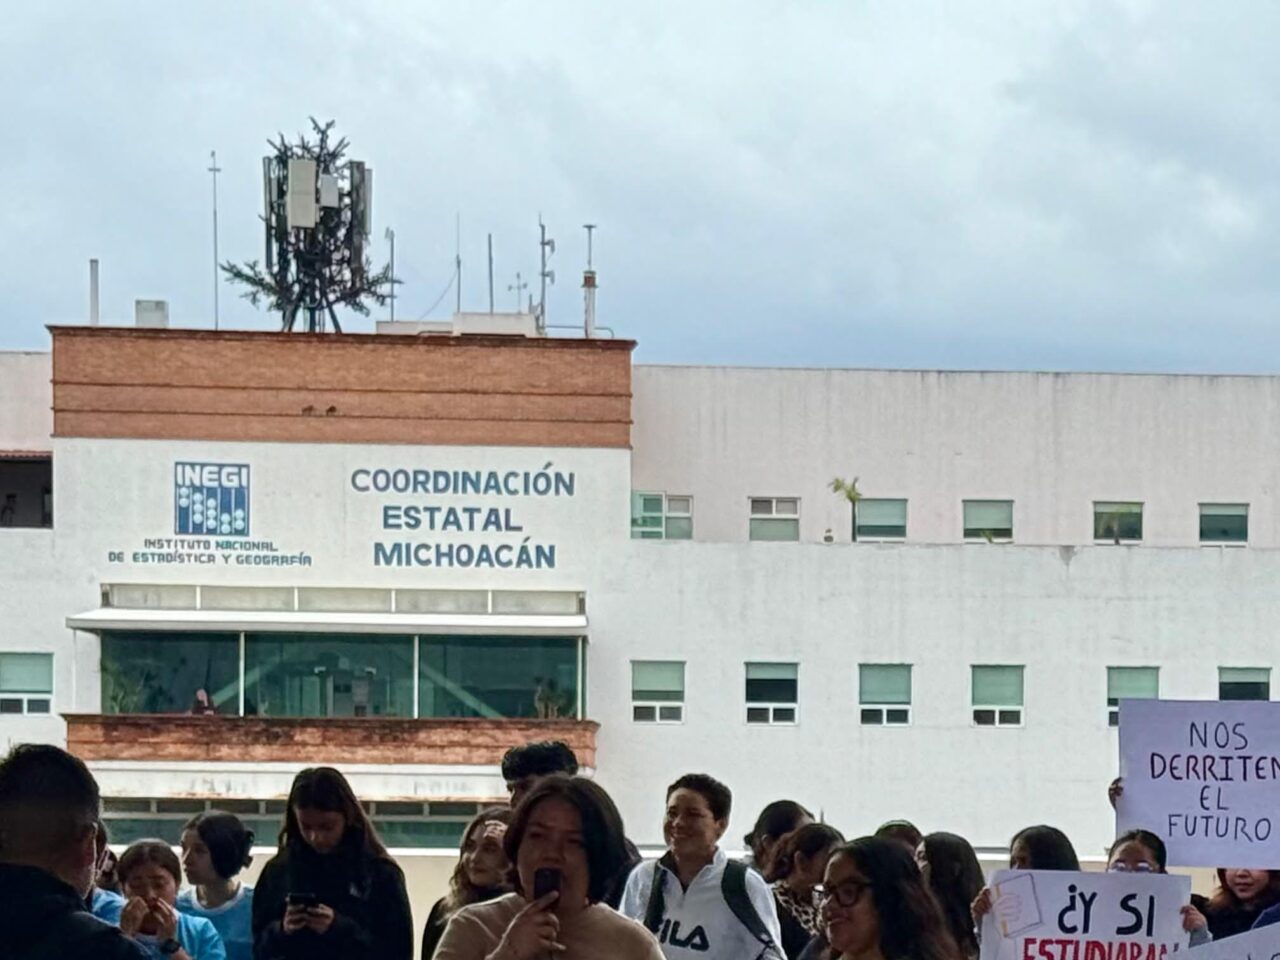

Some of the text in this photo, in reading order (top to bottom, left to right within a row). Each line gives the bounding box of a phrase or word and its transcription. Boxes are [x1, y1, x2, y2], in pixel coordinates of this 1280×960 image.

[176, 464, 248, 488] INEGI
[351, 460, 575, 496] COORDINACIÓN
[382, 505, 523, 532] ESTATAL
[108, 550, 312, 566] DE ESTADÍSTICA Y GEOGRAFÍA
[144, 538, 278, 552] INSTITUTO NACIONAL
[373, 536, 556, 569] MICHOACÁN
[1189, 721, 1249, 750] NOS
[1200, 785, 1229, 811] EL
[1168, 814, 1272, 842] FUTURO
[1057, 884, 1155, 937] ¿Y SI
